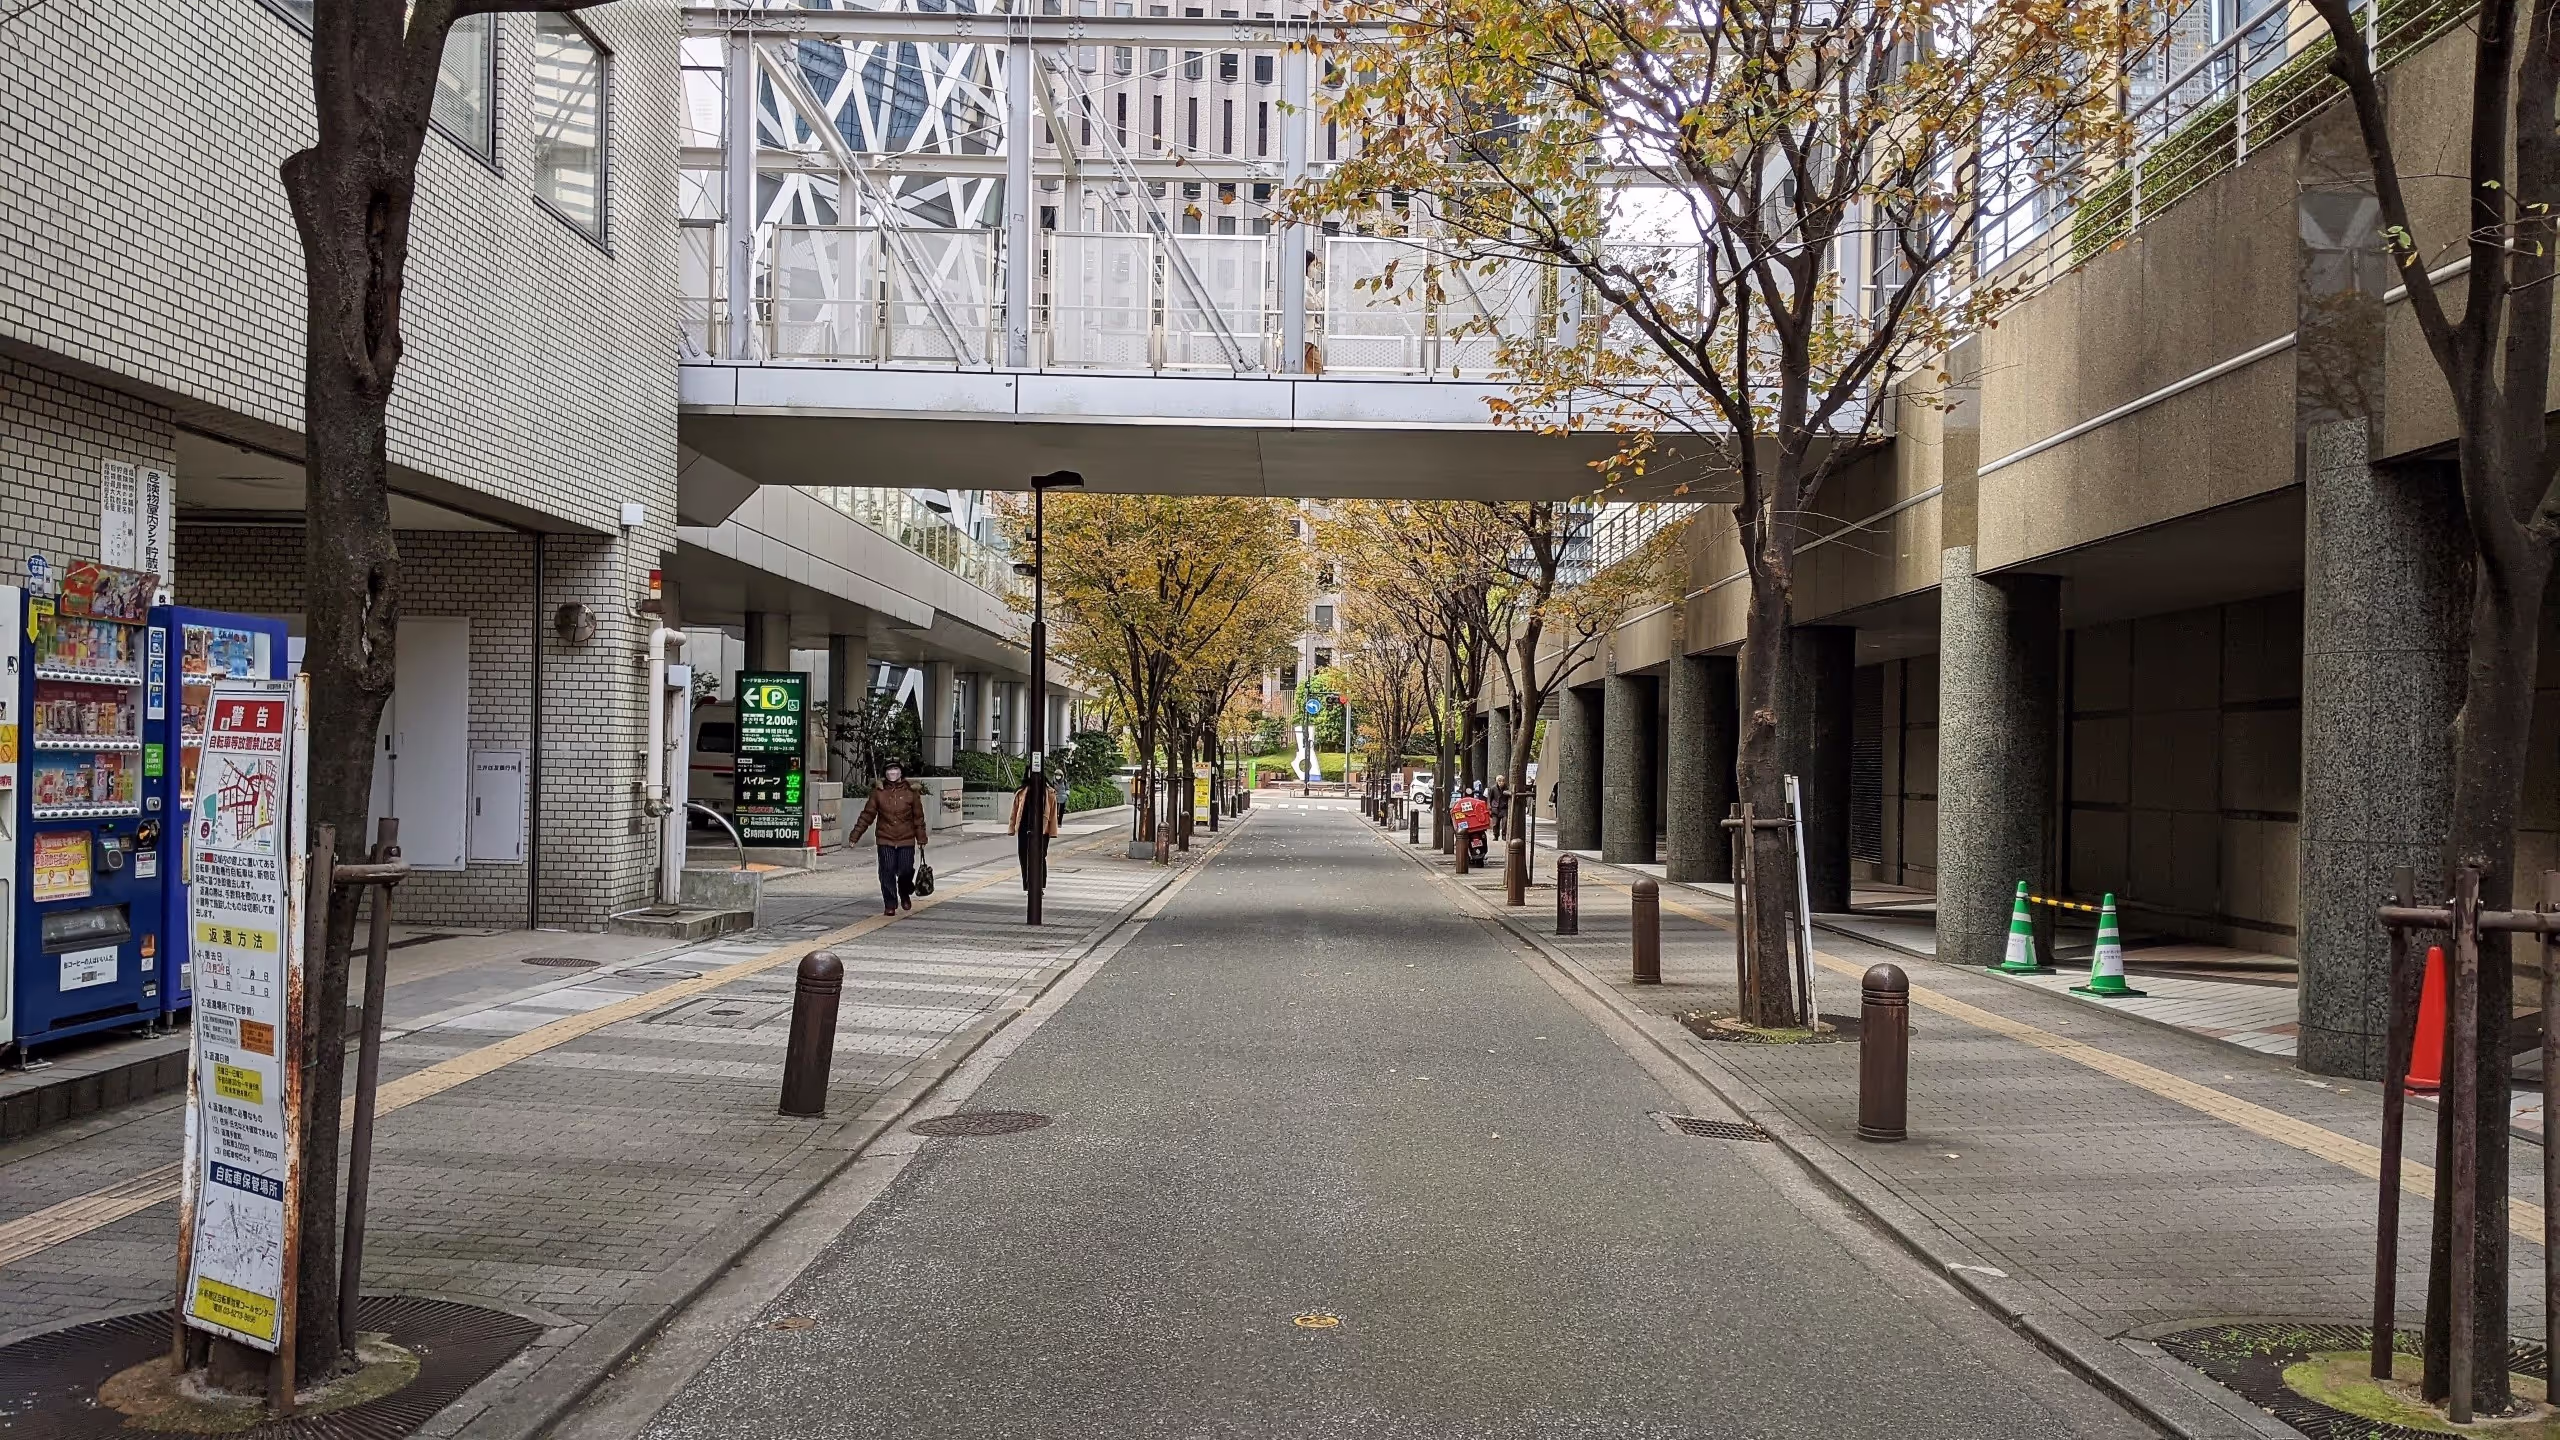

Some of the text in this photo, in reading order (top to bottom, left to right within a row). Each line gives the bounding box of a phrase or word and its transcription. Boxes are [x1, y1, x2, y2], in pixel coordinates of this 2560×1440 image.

[231, 705, 268, 728] 警告
[209, 735, 281, 752] 自転車等放置禁止区域
[208, 928, 263, 950] 返還方法
[216, 1166, 278, 1198] 自転車保管場所
